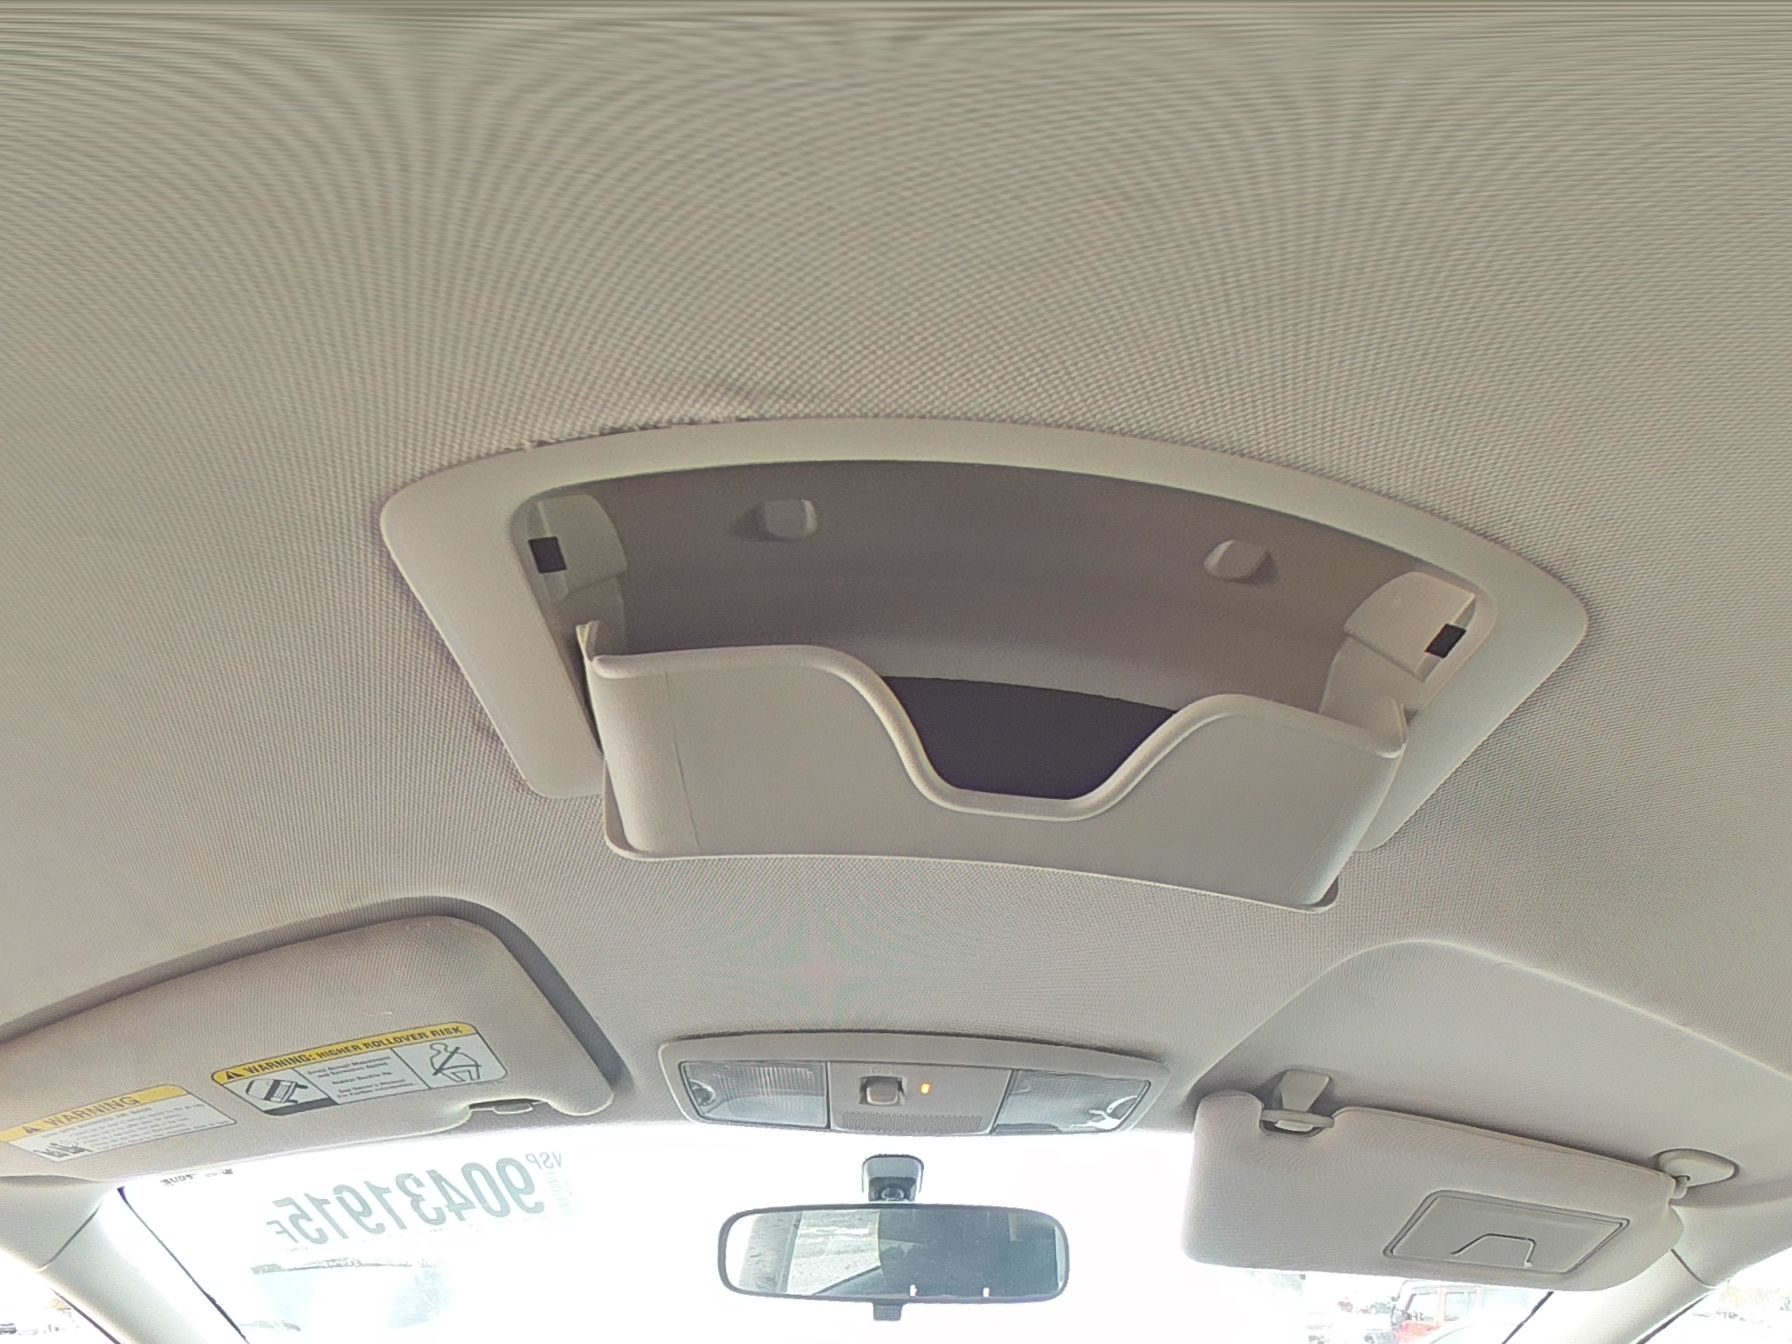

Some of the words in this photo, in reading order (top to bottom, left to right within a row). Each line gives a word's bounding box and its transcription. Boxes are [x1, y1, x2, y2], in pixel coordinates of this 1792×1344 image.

[244, 1054, 316, 1075] WARNING:
[317, 1043, 361, 1060] HIGHER
[363, 1032, 429, 1050] ROLLOVER
[431, 1026, 463, 1038] RISK
[44, 1095, 140, 1127] WARNING
